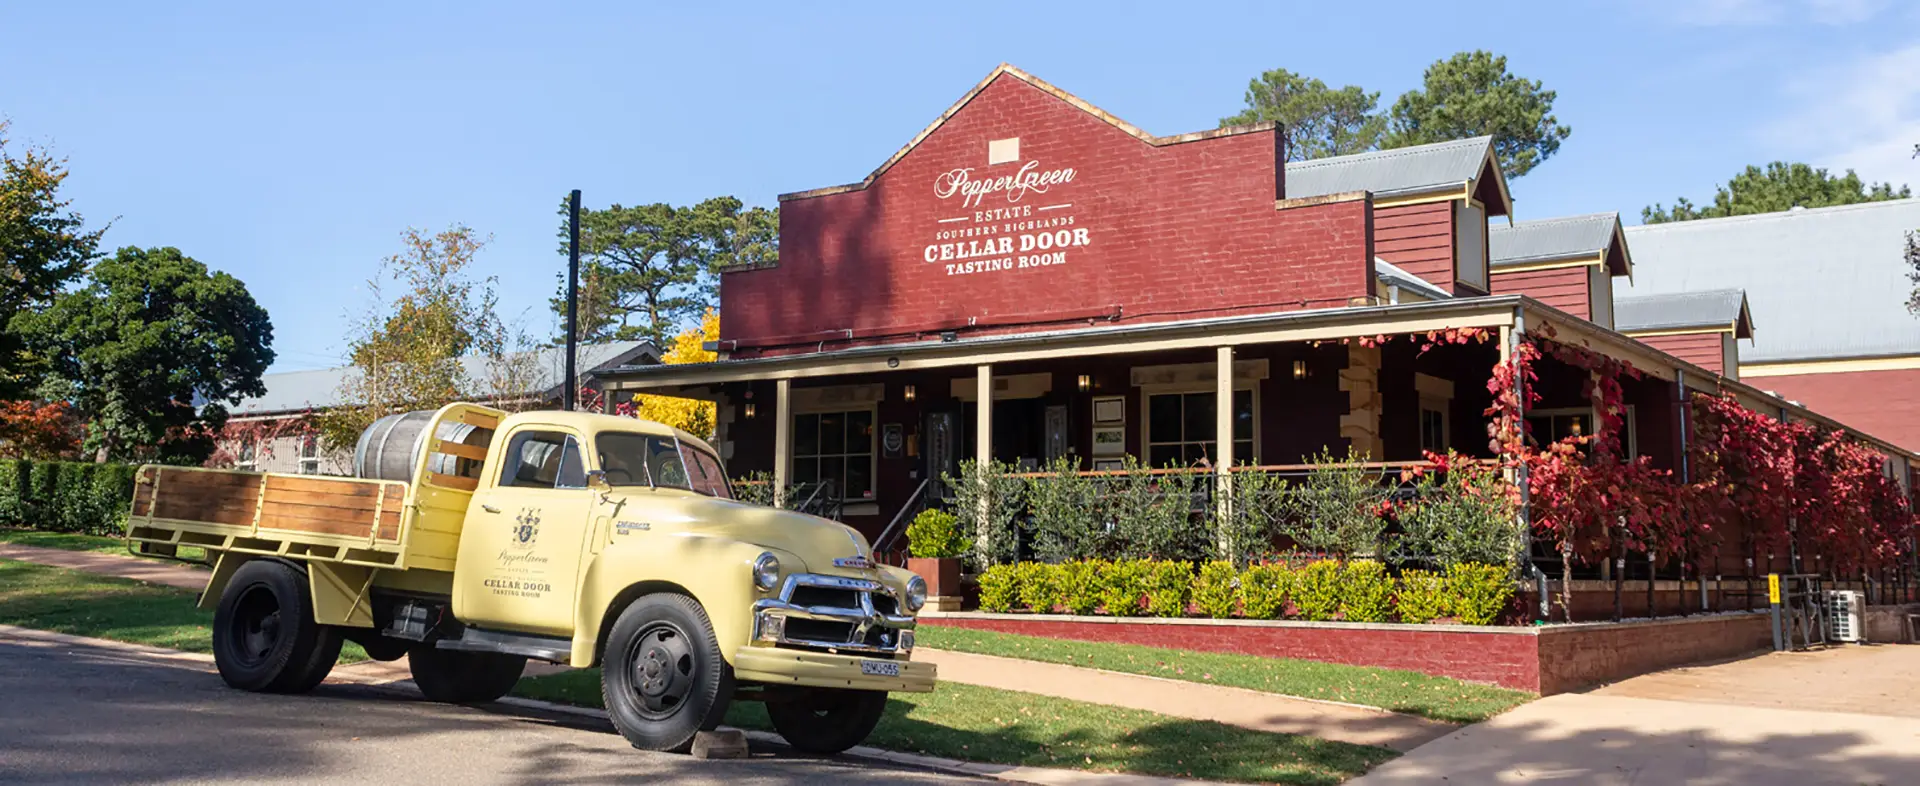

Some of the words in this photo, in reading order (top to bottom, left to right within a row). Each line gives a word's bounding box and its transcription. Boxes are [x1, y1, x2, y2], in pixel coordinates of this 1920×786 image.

[975, 205, 1032, 223] ESTATE
[936, 225, 998, 240] SOUTHERN
[1004, 216, 1075, 232] HIGHLANDS
[924, 236, 1014, 263] CELLAR
[1019, 228, 1091, 253] DOOR
[946, 257, 1013, 276] TASTING
[1018, 252, 1066, 269] ROOM
[484, 579, 521, 590] CELLAR
[523, 582, 552, 592] DOOR
[492, 588, 520, 597] TASTING
[521, 590, 541, 598] ROOM
